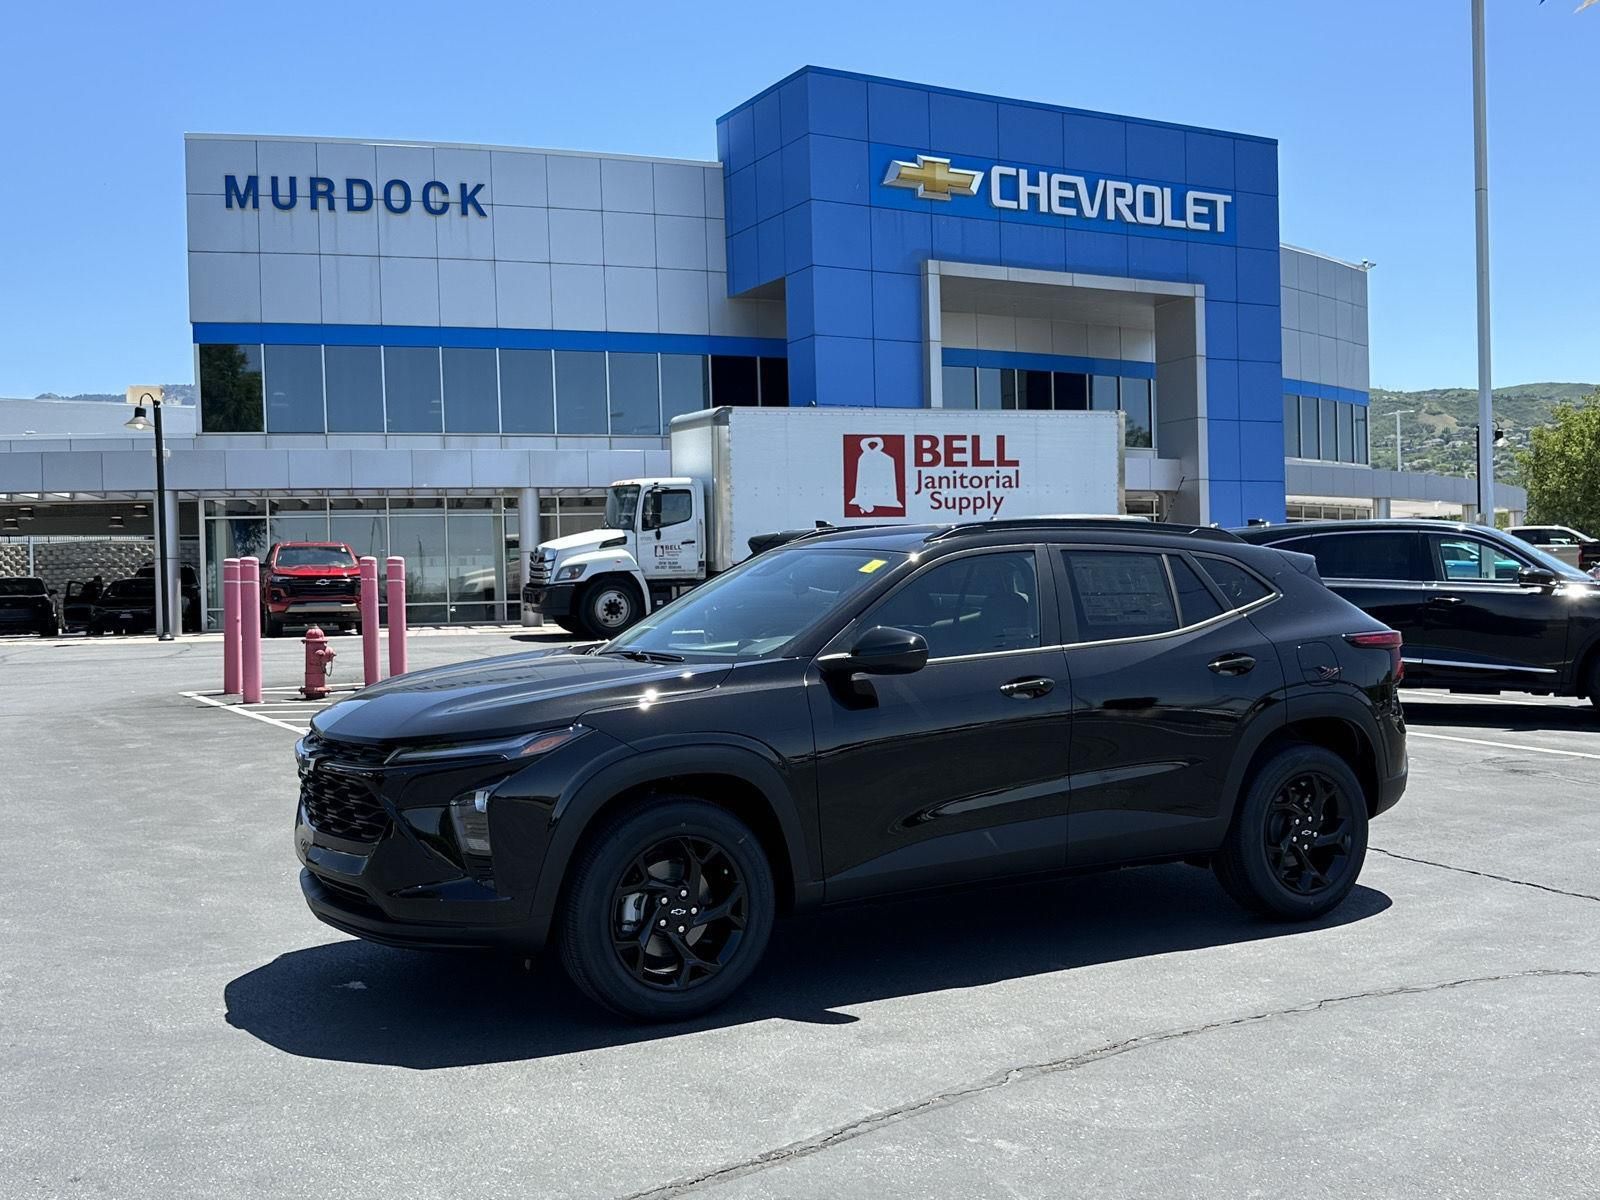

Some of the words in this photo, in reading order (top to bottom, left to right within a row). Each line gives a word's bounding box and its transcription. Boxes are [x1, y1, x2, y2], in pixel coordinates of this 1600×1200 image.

[224, 174, 488, 218] MURDOCK
[990, 165, 1233, 234] CHEVROLET
[913, 434, 1020, 468] BELL
[914, 469, 1020, 495] Janitorial
[929, 490, 1005, 516] Supply
